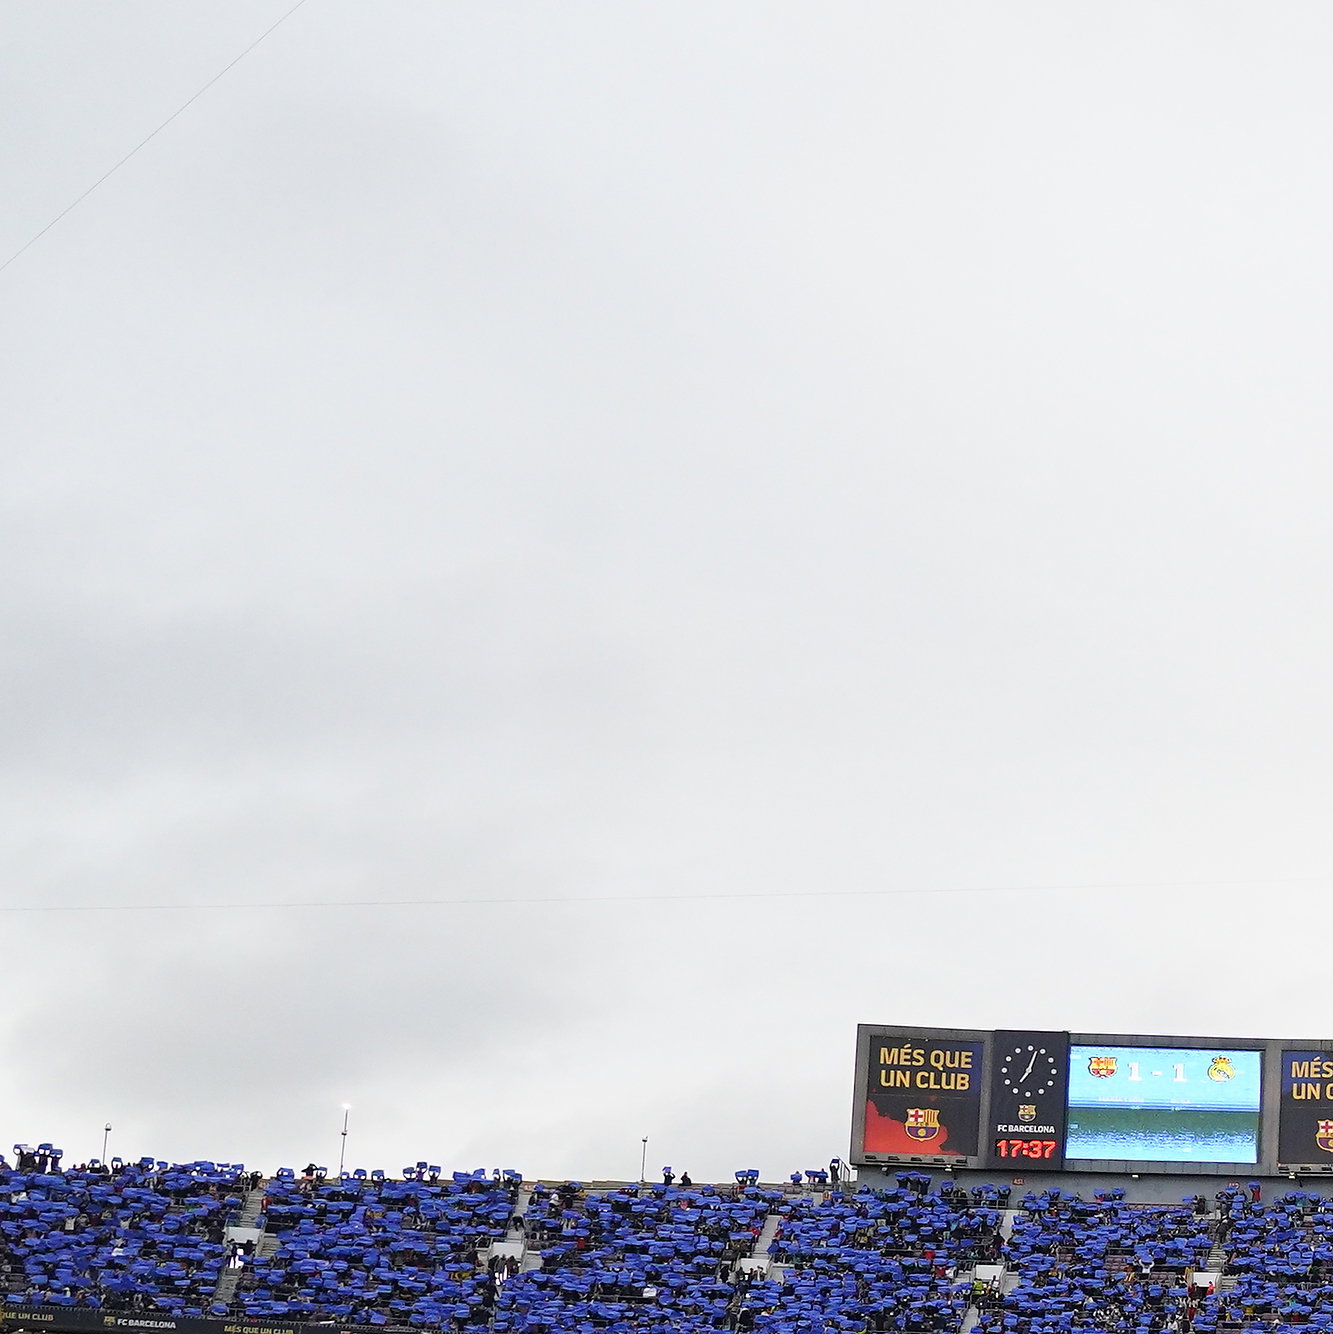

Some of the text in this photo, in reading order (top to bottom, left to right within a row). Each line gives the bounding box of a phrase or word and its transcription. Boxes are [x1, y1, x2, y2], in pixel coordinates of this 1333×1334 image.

[880, 1044, 973, 1070] MÉS QUE
[1128, 1062, 1142, 1081] 1
[1172, 1064, 1187, 1083] 1
[1291, 1059, 1333, 1079] MÉS
[880, 1070, 970, 1091] UN CLUB
[1293, 1083, 1317, 1100] UN
[997, 1125, 1055, 1133] FC BARCELONA
[996, 1140, 1055, 1159] 17:37
[118, 1318, 176, 1328] FC BARCELONA
[224, 1326, 240, 1334] MÉS
[240, 1327, 258, 1334] QUE
